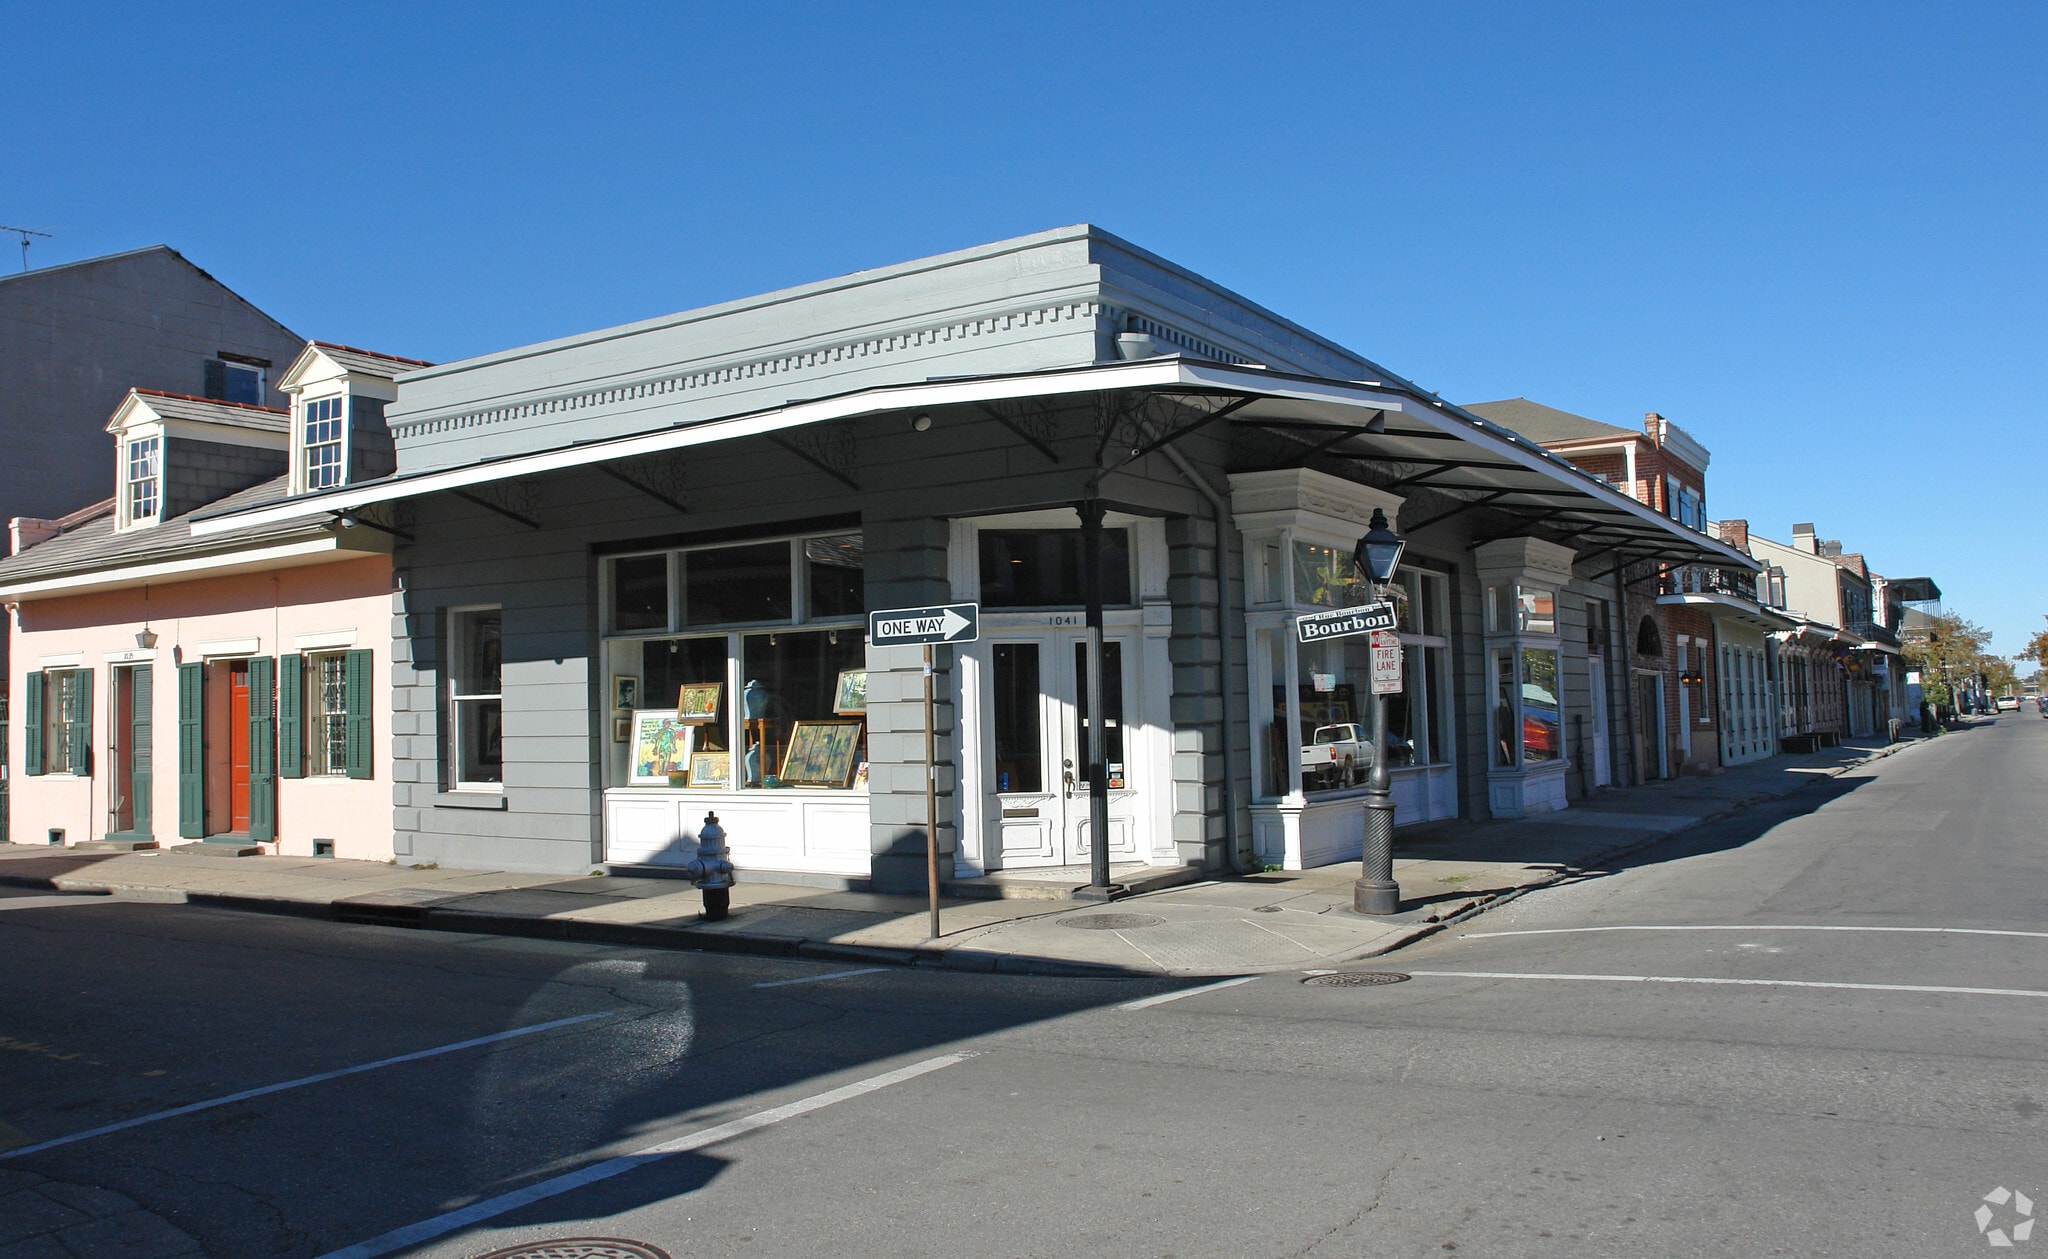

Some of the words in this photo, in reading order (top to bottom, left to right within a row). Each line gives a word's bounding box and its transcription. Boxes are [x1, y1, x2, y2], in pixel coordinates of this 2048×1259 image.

[1049, 616, 1077, 625] 1041
[1303, 615, 1390, 637] Bourbon
[882, 620, 912, 635] ONE
[916, 618, 945, 633] WAY
[1377, 649, 1394, 659] FIRE
[1377, 660, 1396, 671] LANE
